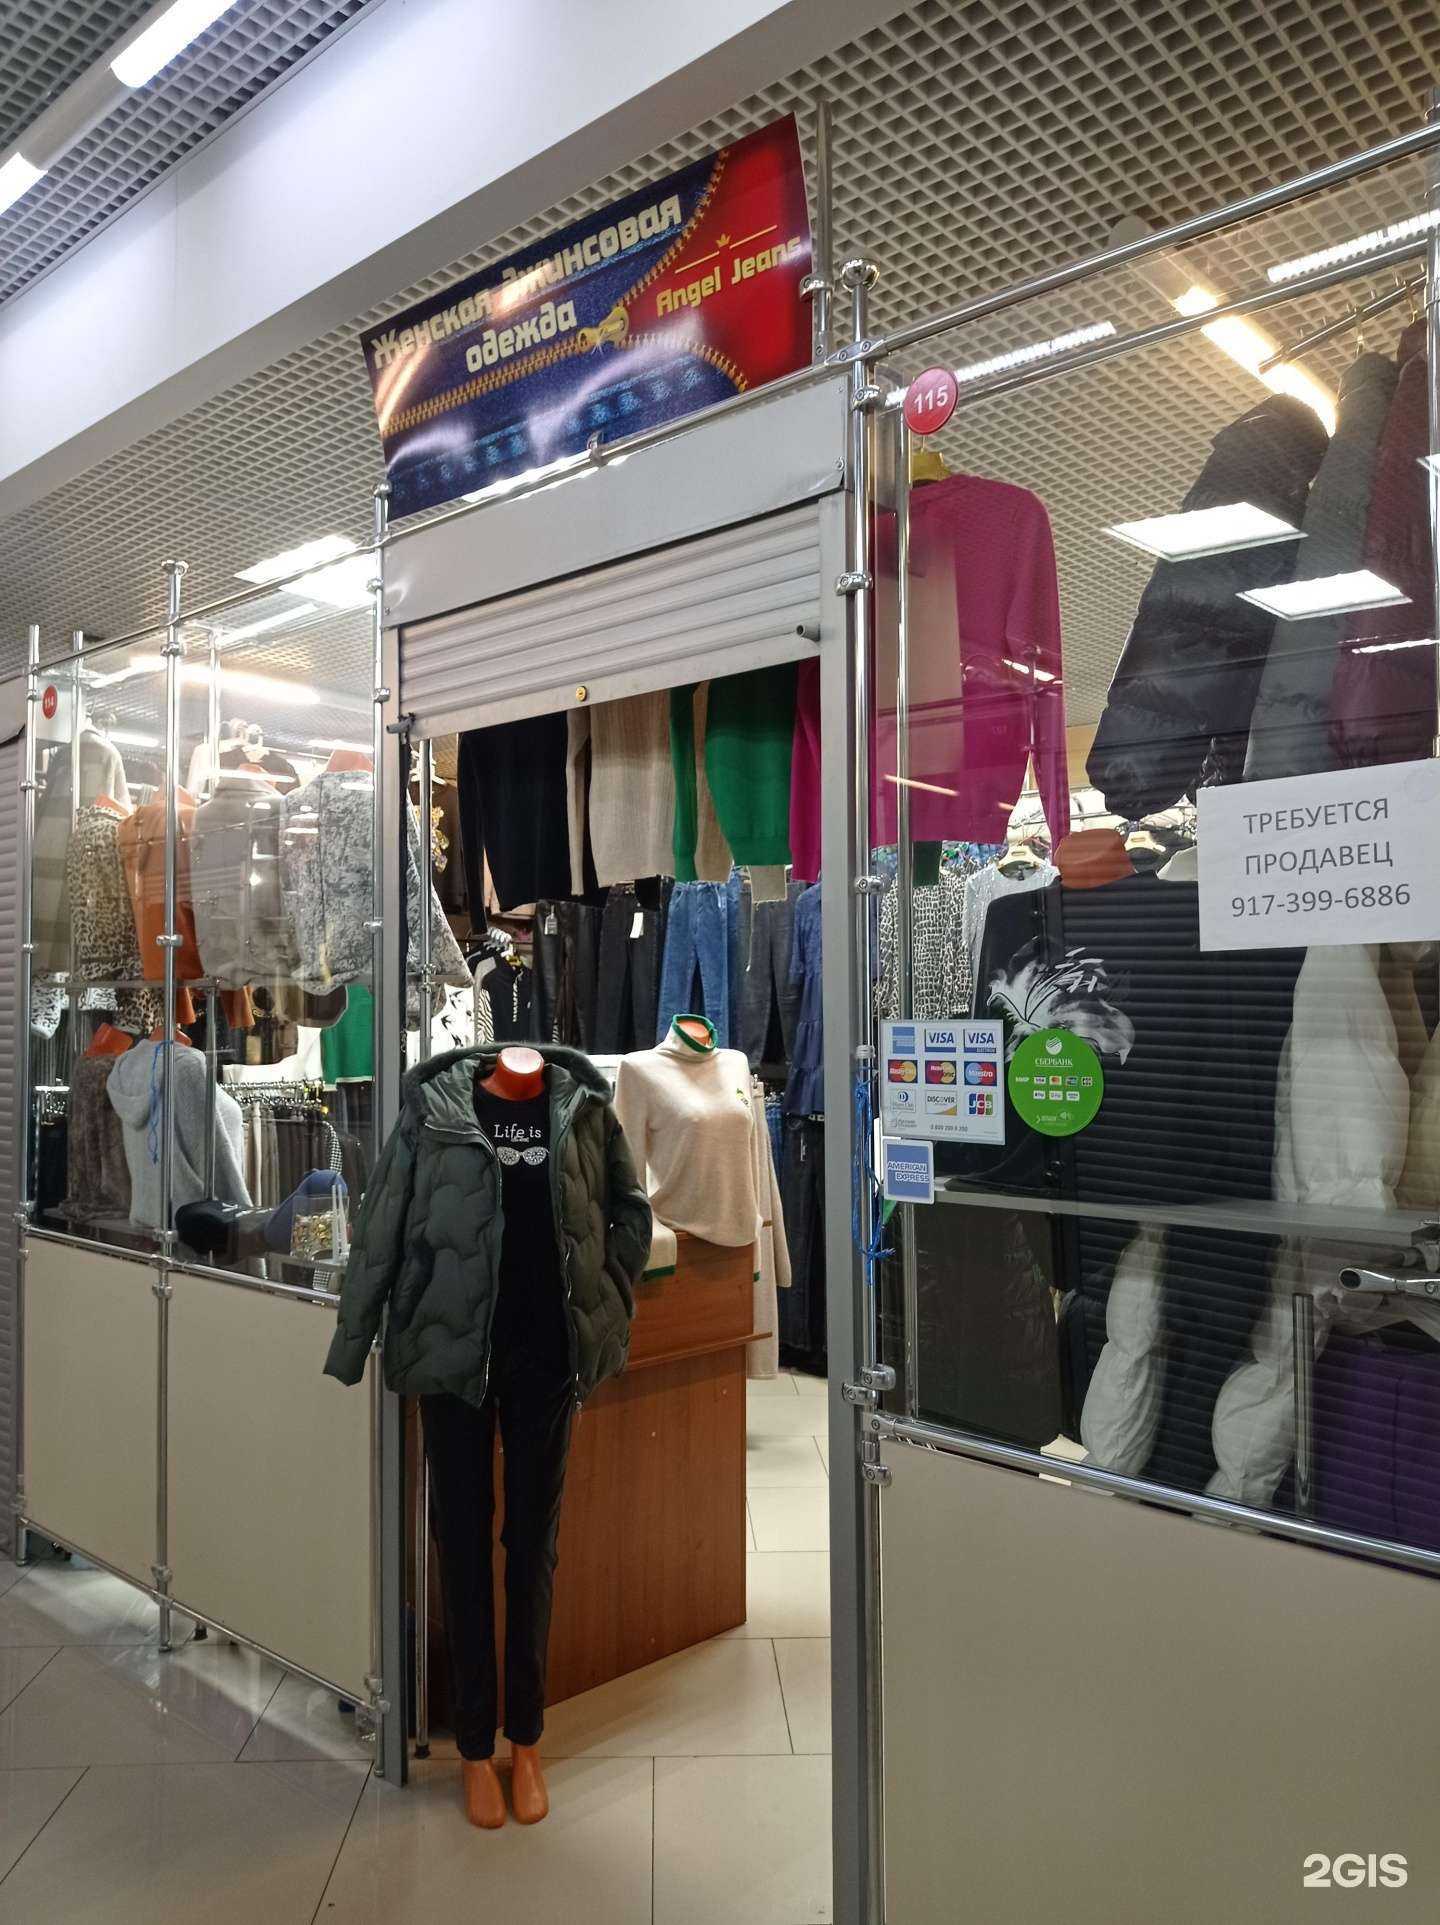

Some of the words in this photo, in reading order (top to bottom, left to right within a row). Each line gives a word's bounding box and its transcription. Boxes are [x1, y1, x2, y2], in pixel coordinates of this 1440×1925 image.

[656, 266, 722, 318] Angel
[731, 236, 801, 285] Jeans
[371, 288, 493, 369] Женская
[465, 301, 577, 374] одежда
[914, 385, 948, 414] 115
[1243, 798, 1389, 834] ТРЕБУЕТСЯ
[1245, 841, 1393, 875] ПРОДАВЕЦ
[1231, 883, 1411, 918] 917-399-6886
[929, 1032, 955, 1044] VISA
[968, 1032, 995, 1045] VISA
[1034, 1057, 1073, 1067] СБЕРБАНК
[969, 1097, 993, 1111] JCB
[494, 1123, 525, 1141] Life
[530, 1126, 542, 1138] is
[888, 1161, 928, 1172] AMERICAN
[895, 1172, 930, 1183] EXPRESS
